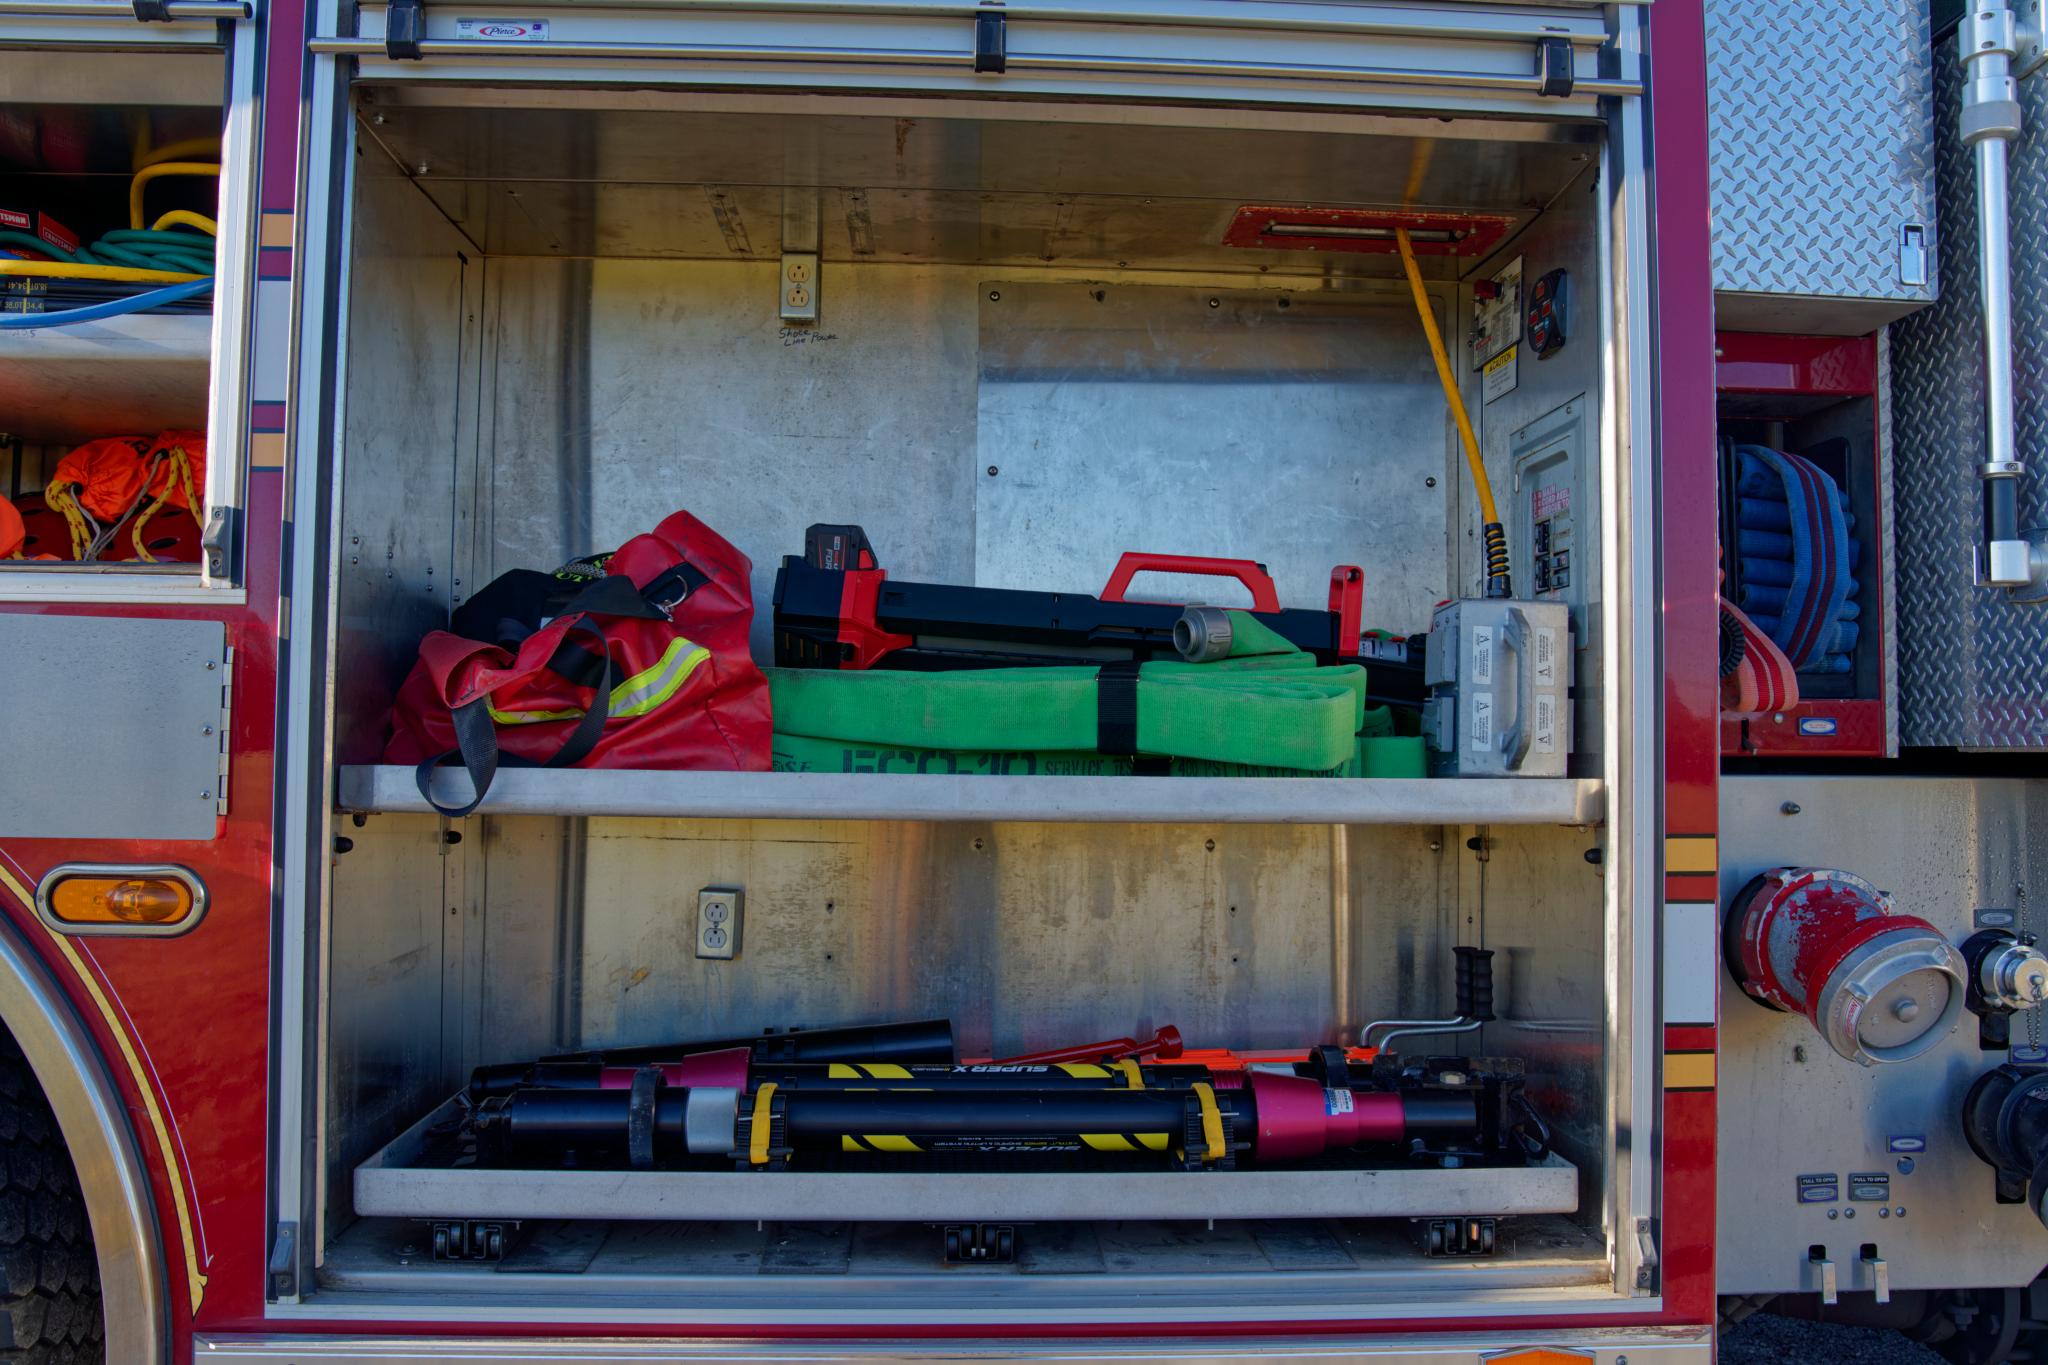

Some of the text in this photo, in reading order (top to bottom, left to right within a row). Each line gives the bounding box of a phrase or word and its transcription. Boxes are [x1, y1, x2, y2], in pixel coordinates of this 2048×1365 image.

[489, 26, 517, 37] Pierce
[1492, 351, 1513, 371] CAUTION
[952, 1065, 968, 1073] X
[971, 1065, 1049, 1073] SUPER
